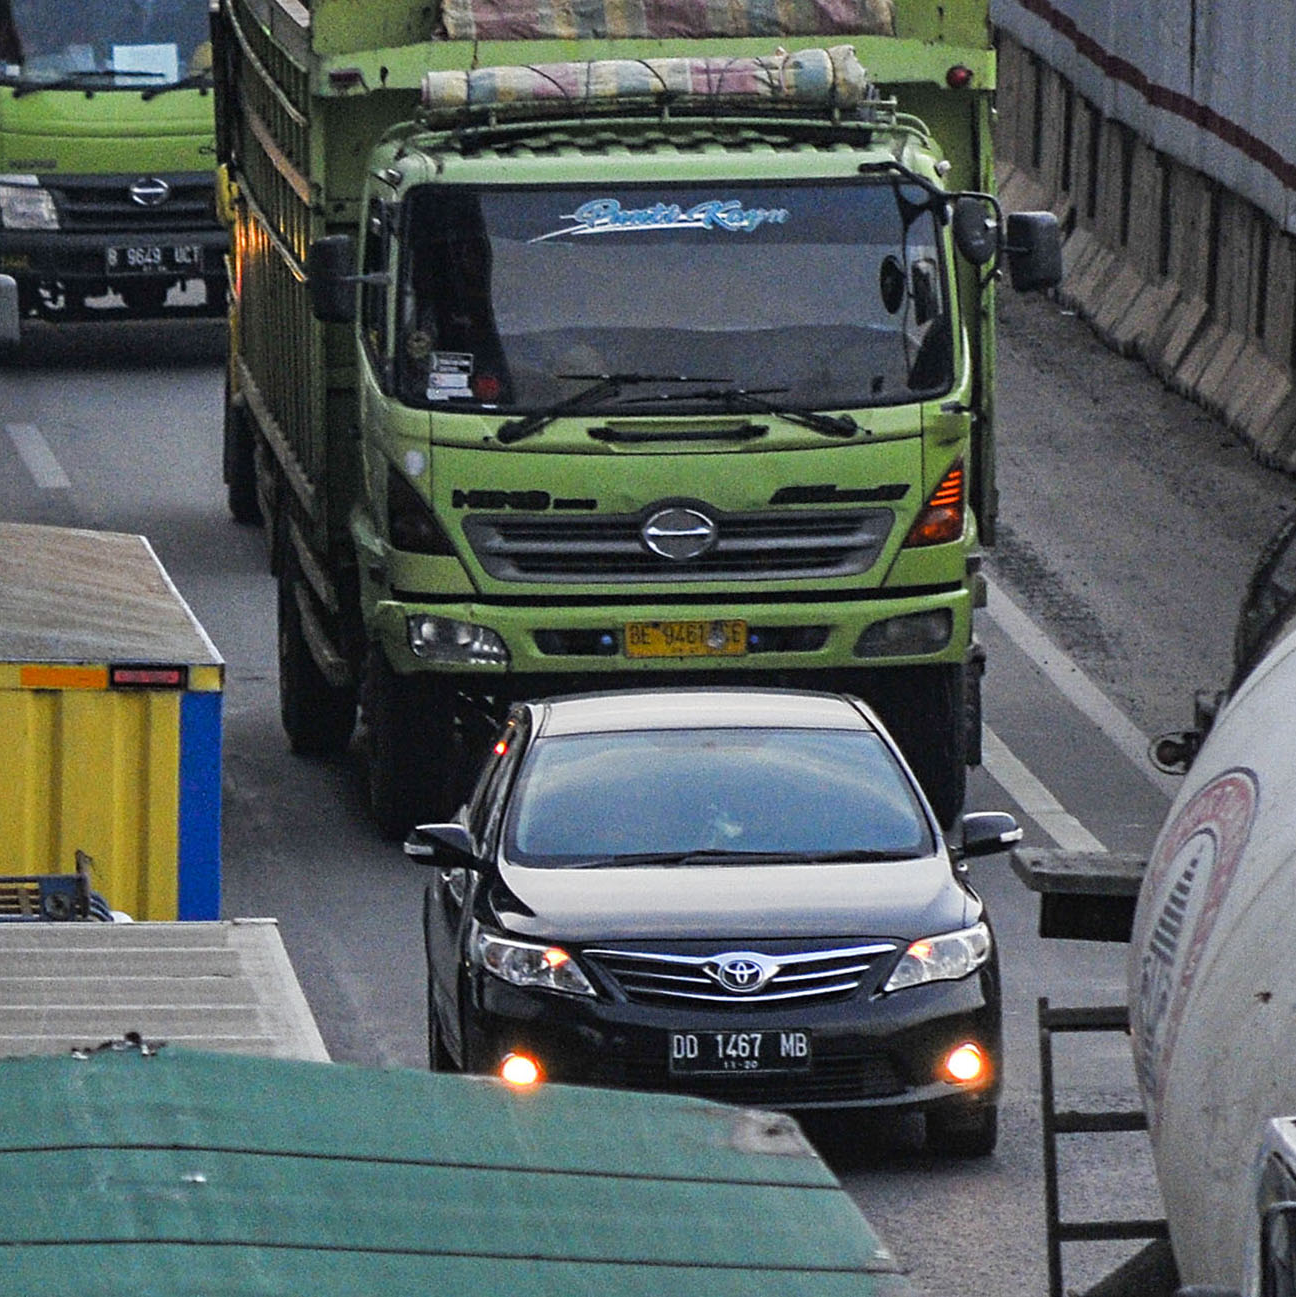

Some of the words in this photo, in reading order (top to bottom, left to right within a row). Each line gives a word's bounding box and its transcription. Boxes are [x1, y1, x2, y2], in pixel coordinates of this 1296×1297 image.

[108, 247, 118, 266] B
[672, 1034, 699, 1059] DD
[715, 1033, 763, 1059] 1467
[780, 1032, 808, 1057] MB
